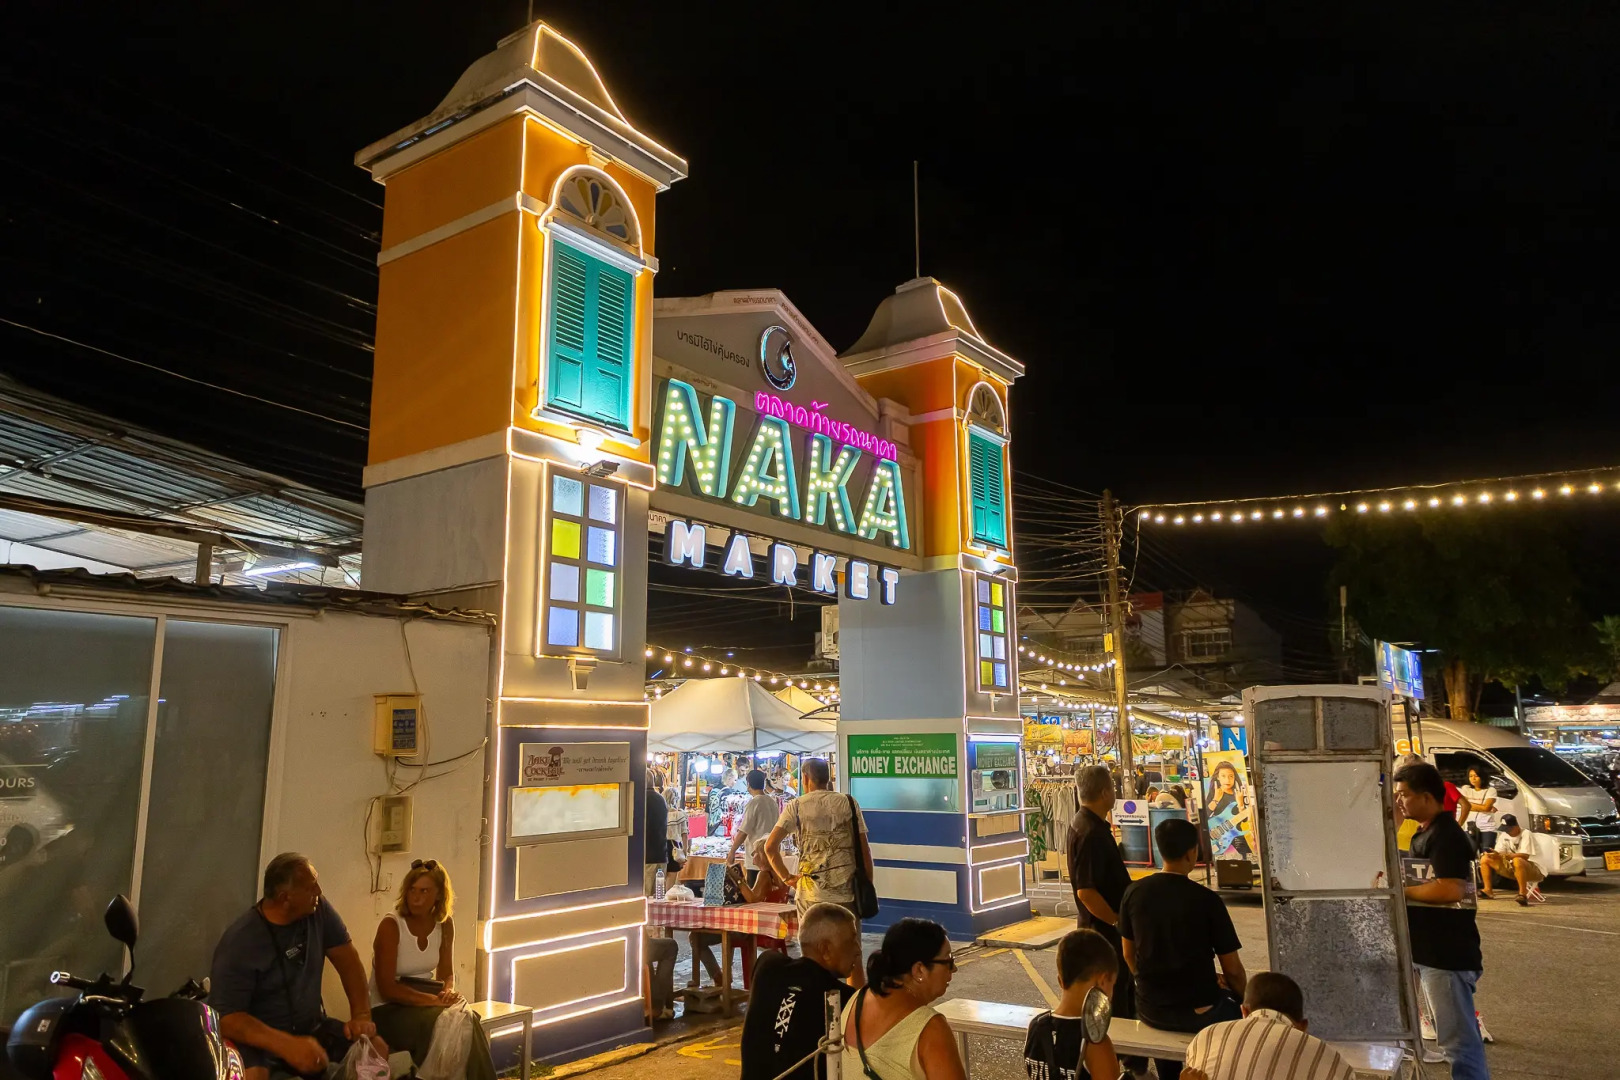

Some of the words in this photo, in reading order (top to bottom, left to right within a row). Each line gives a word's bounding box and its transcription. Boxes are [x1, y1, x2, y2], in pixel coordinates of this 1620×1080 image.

[755, 391, 898, 462] ตลาดท้ายรถนาคา
[656, 378, 911, 550] NAKA
[648, 513, 668, 523] นาคา
[668, 520, 899, 605] MARKET
[1396, 736, 1422, 756] et
[852, 756, 889, 774] MONEY
[895, 756, 957, 775] EXCHANGE
[1411, 863, 1437, 880] TA
